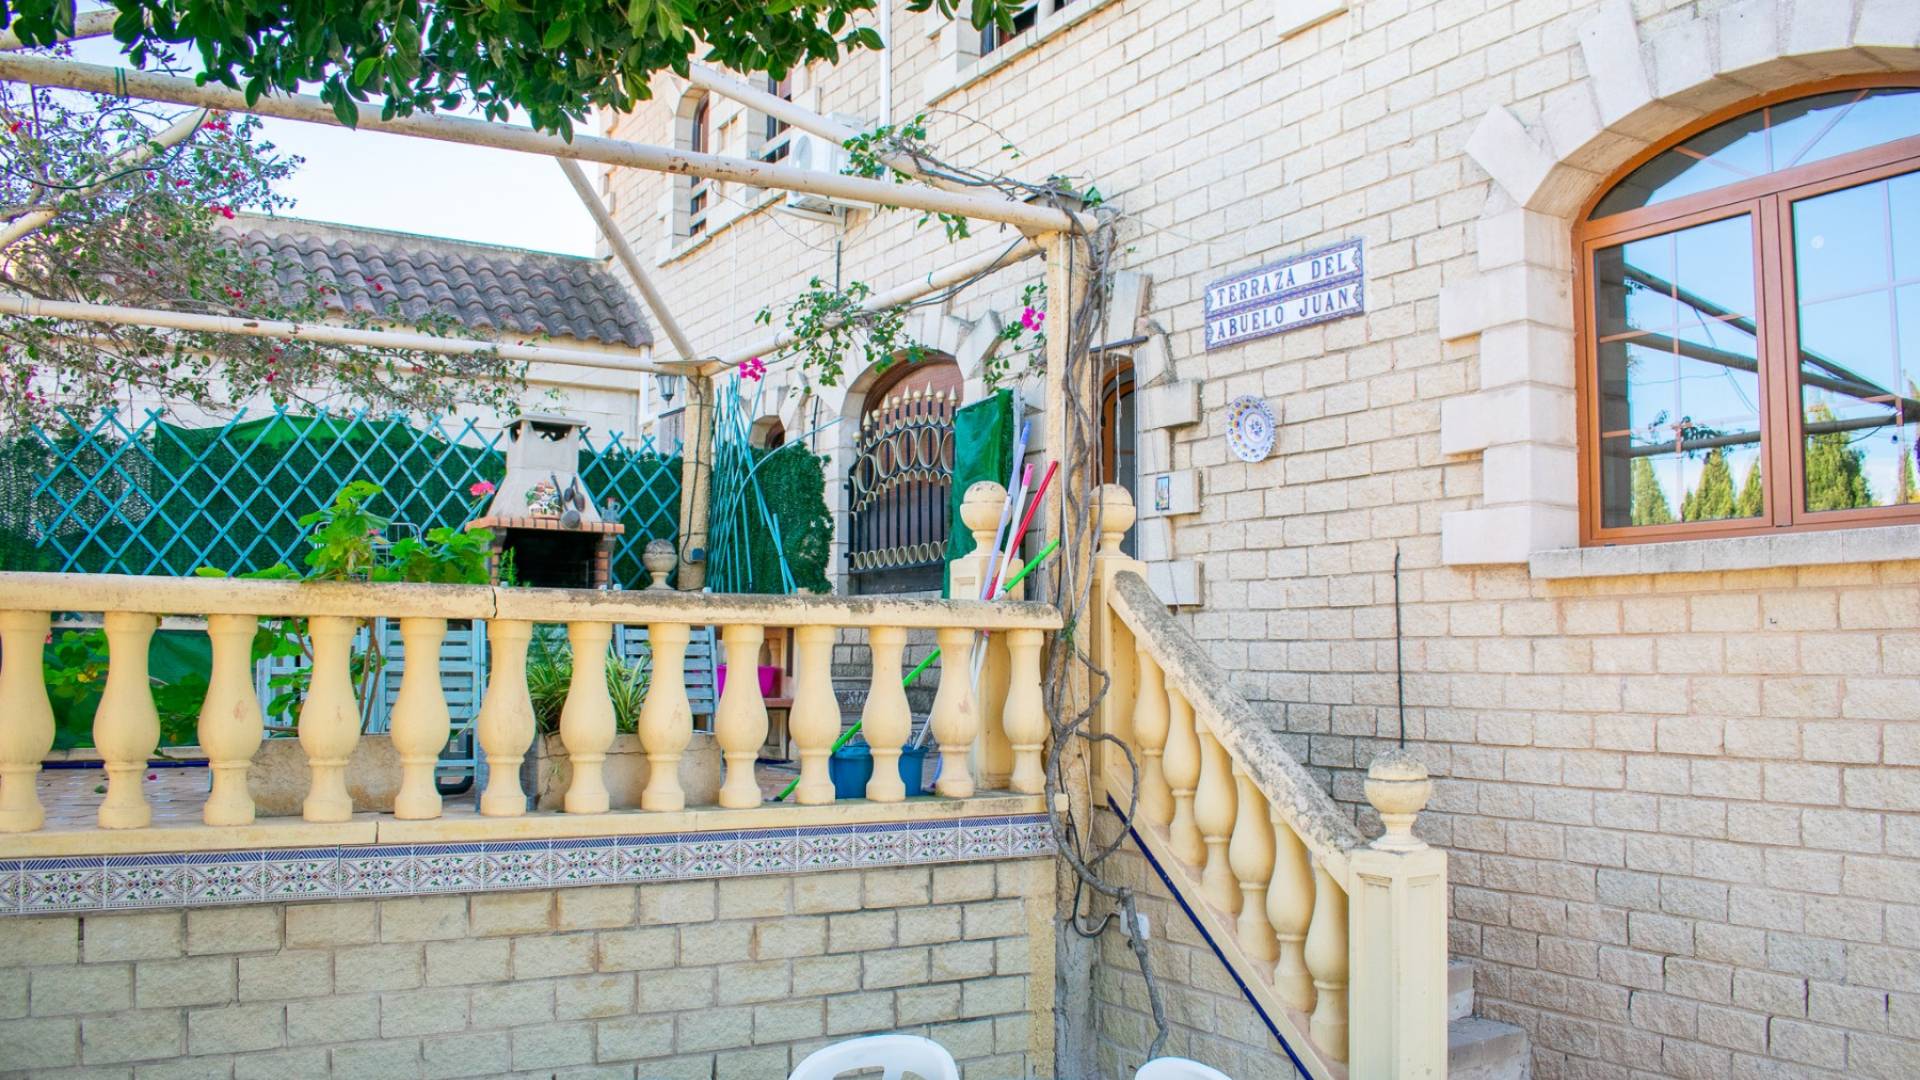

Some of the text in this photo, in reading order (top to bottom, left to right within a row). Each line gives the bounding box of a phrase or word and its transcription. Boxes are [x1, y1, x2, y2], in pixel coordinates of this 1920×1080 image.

[1217, 253, 1347, 306] TERRAZA DEL
[1217, 287, 1348, 339] ABUELO JUAN
